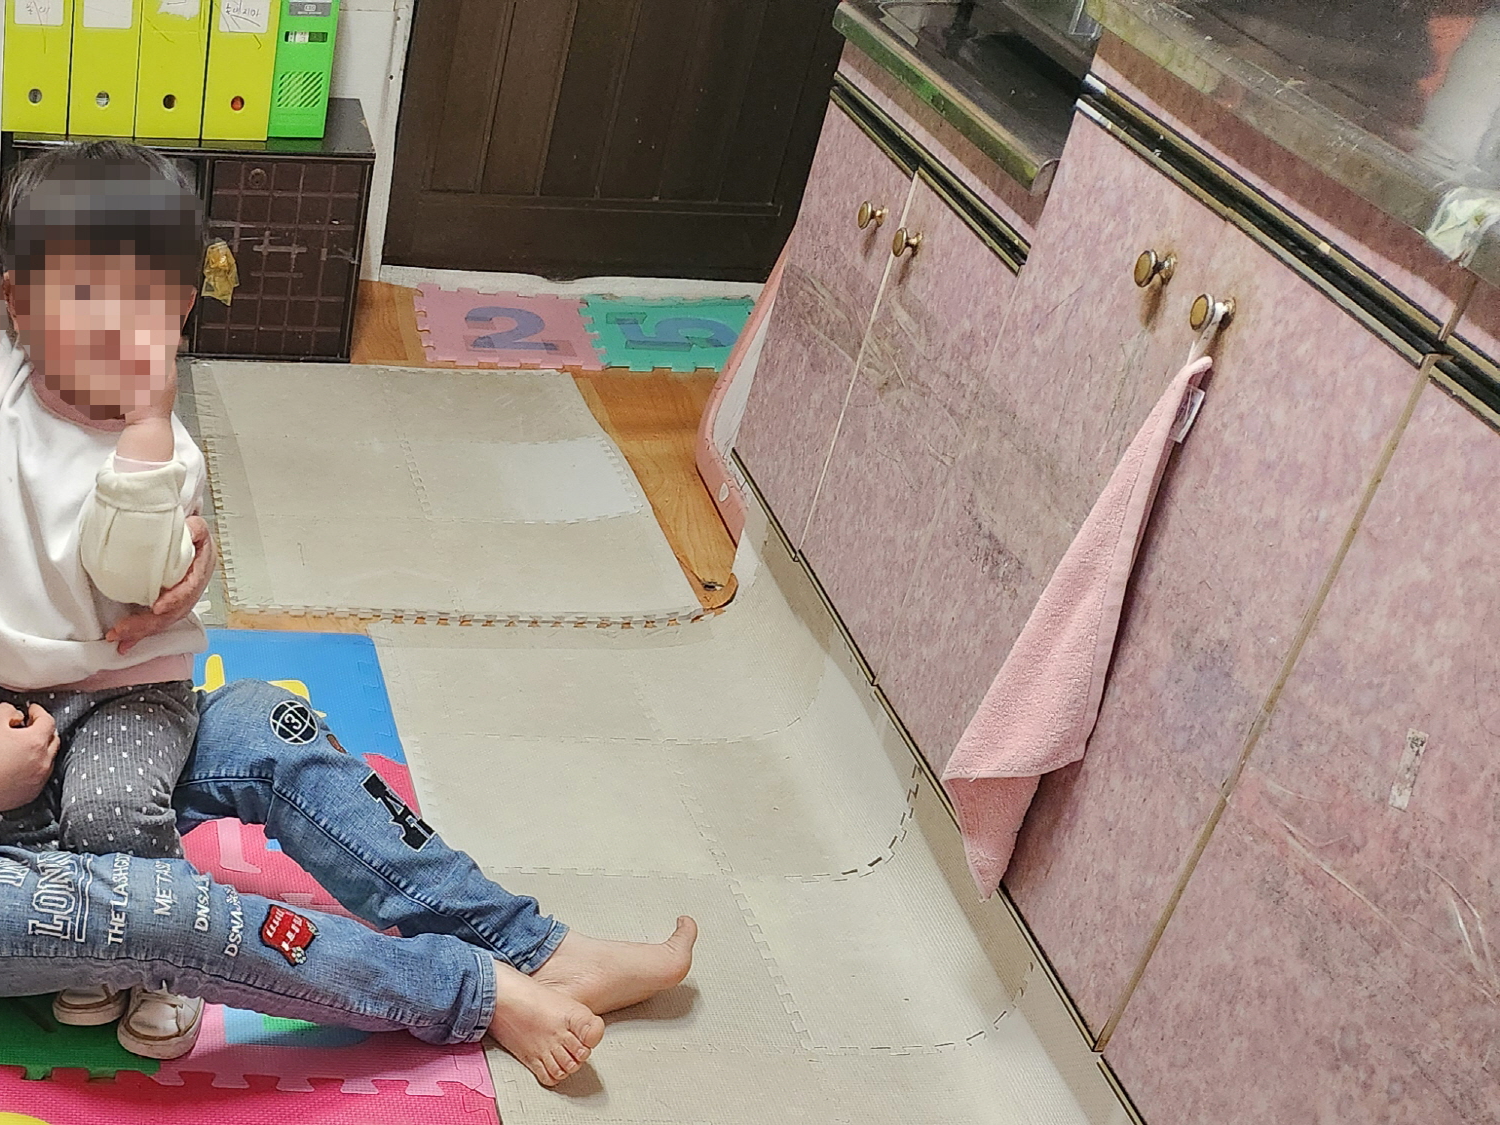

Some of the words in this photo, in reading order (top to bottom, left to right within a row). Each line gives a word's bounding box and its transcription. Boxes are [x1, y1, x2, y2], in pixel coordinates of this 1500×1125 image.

[464, 306, 558, 351] 2
[284, 713, 302, 730] 3
[107, 911, 125, 945] THE
